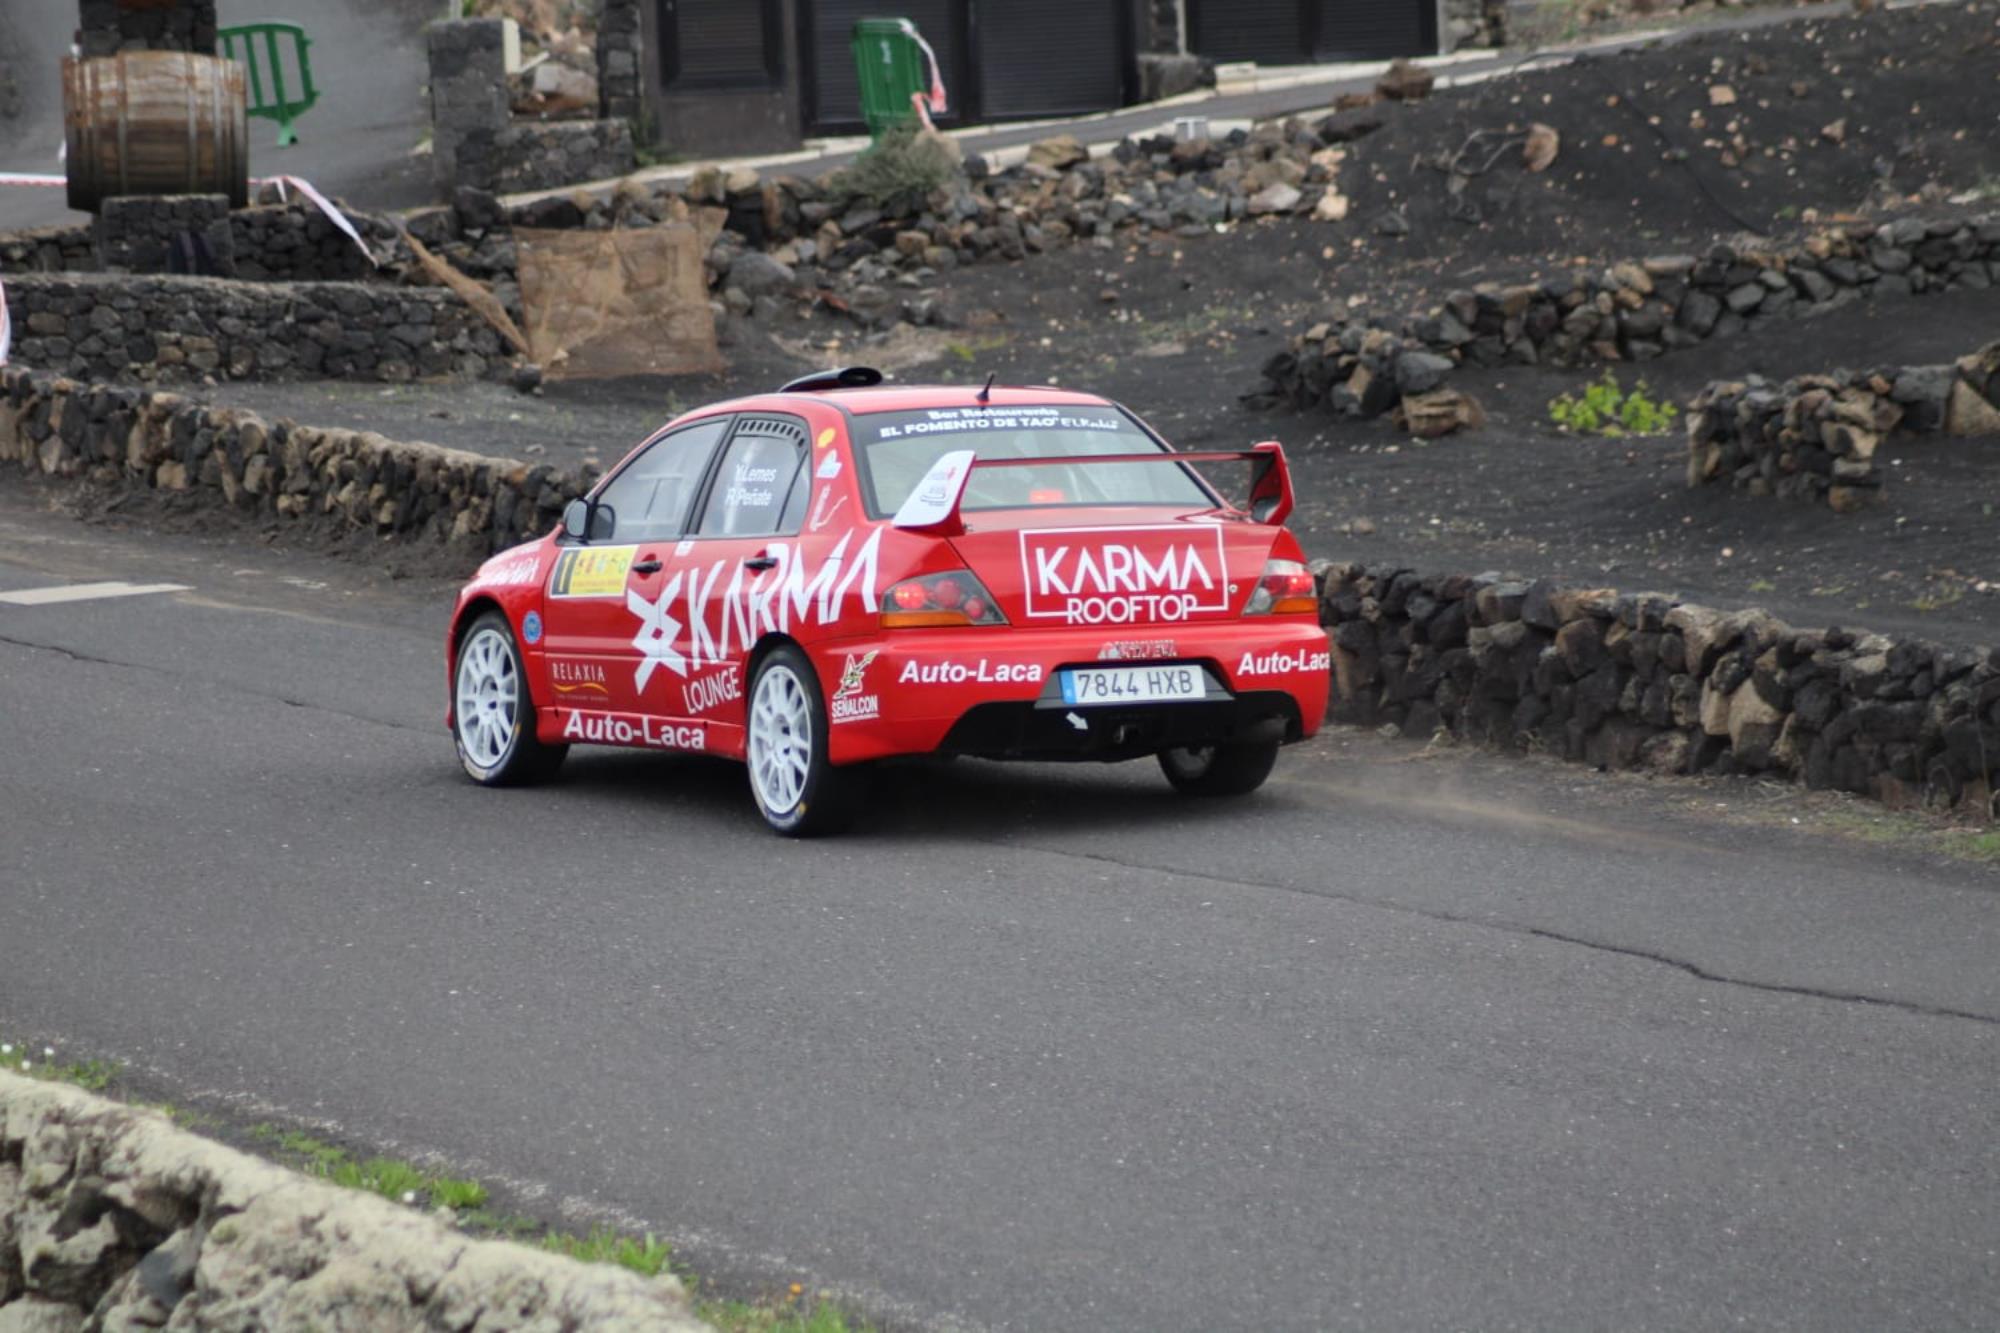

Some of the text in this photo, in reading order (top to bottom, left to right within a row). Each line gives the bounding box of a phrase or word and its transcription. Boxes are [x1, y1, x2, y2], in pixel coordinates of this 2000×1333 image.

[880, 427, 902, 438] EL
[905, 417, 990, 435] FOMENTO
[993, 417, 1017, 428] DE
[1035, 543, 1214, 596] KARMA
[688, 525, 880, 672] KARMA
[1067, 594, 1198, 625] ROOFTOP
[552, 662, 606, 682] RELAXIA
[898, 658, 1042, 683] Auto-Laca
[1077, 669, 1193, 697] 7844 HXB
[682, 666, 741, 714] LOUNGE
[563, 709, 705, 750] Auto-Laca
